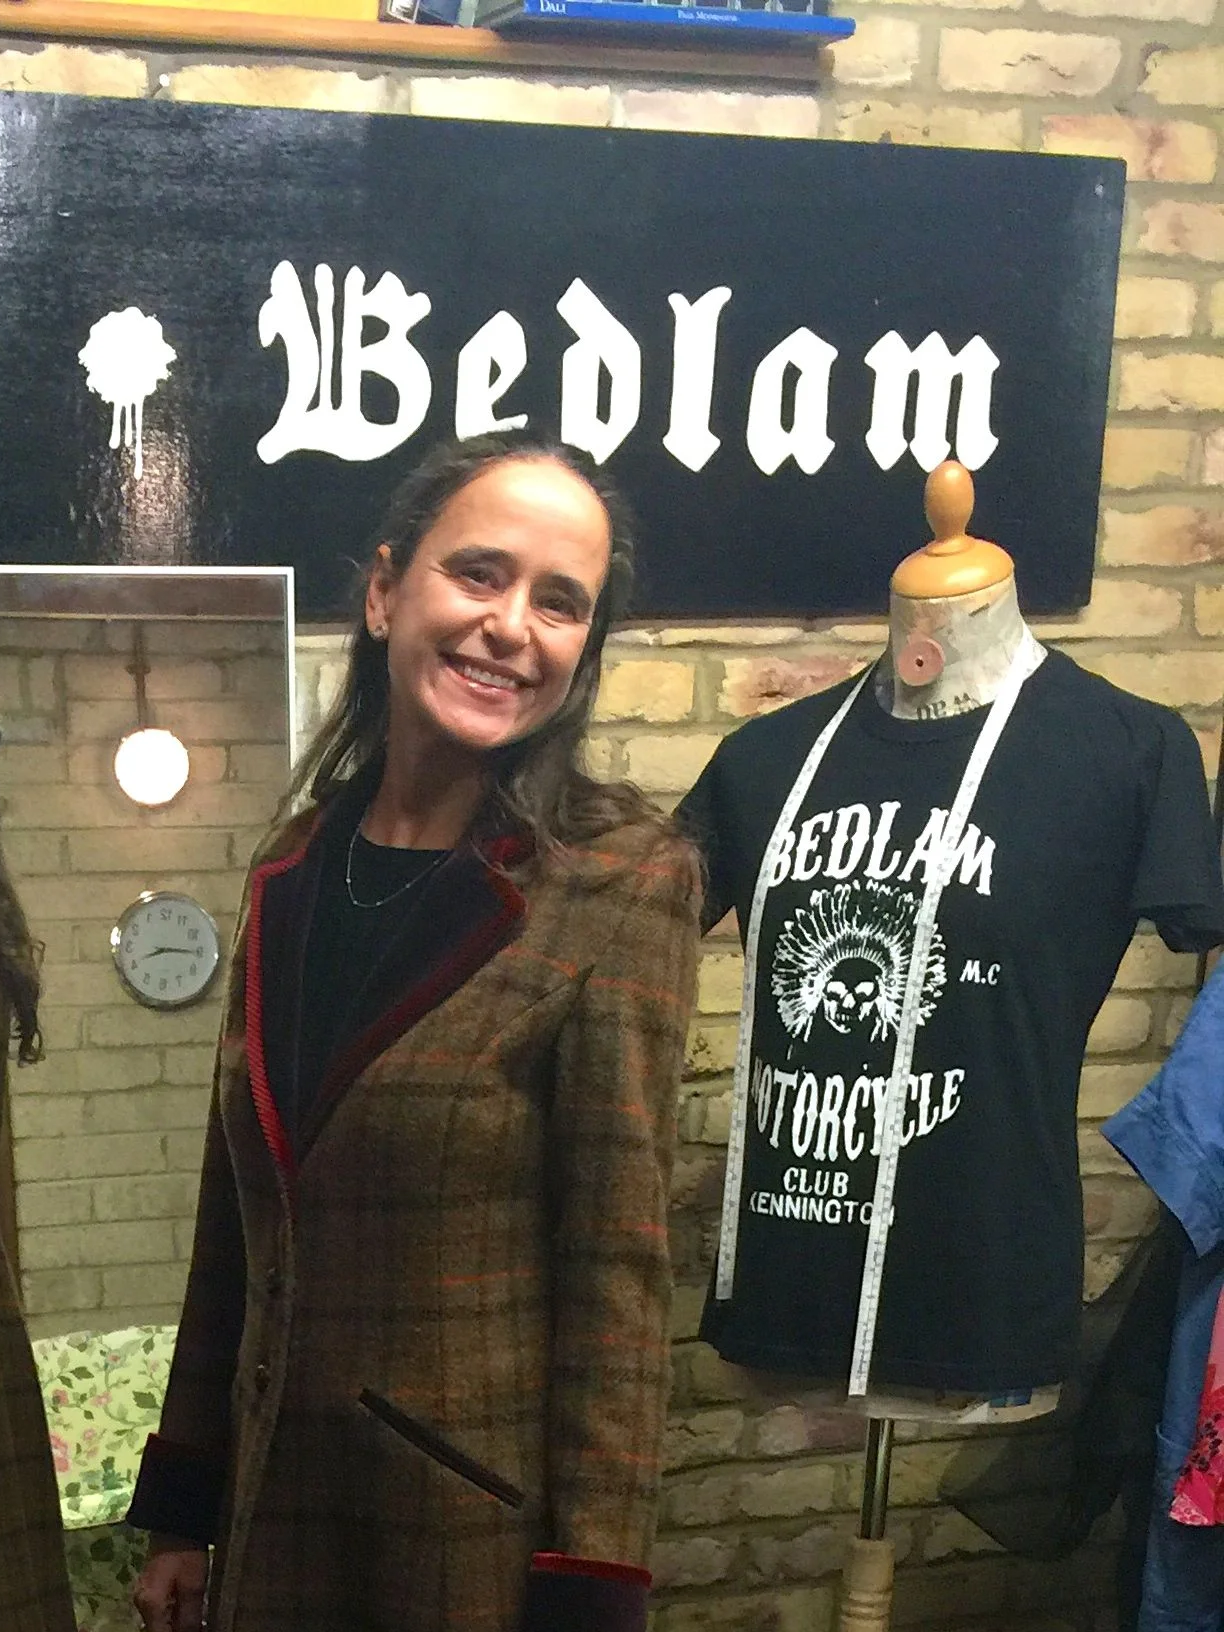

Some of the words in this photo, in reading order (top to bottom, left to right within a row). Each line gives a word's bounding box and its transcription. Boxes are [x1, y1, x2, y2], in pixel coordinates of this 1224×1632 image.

[257, 260, 1000, 475] Bedlam
[783, 1167, 849, 1197] CLUB
[749, 1191, 895, 1226] ENNINGTO
